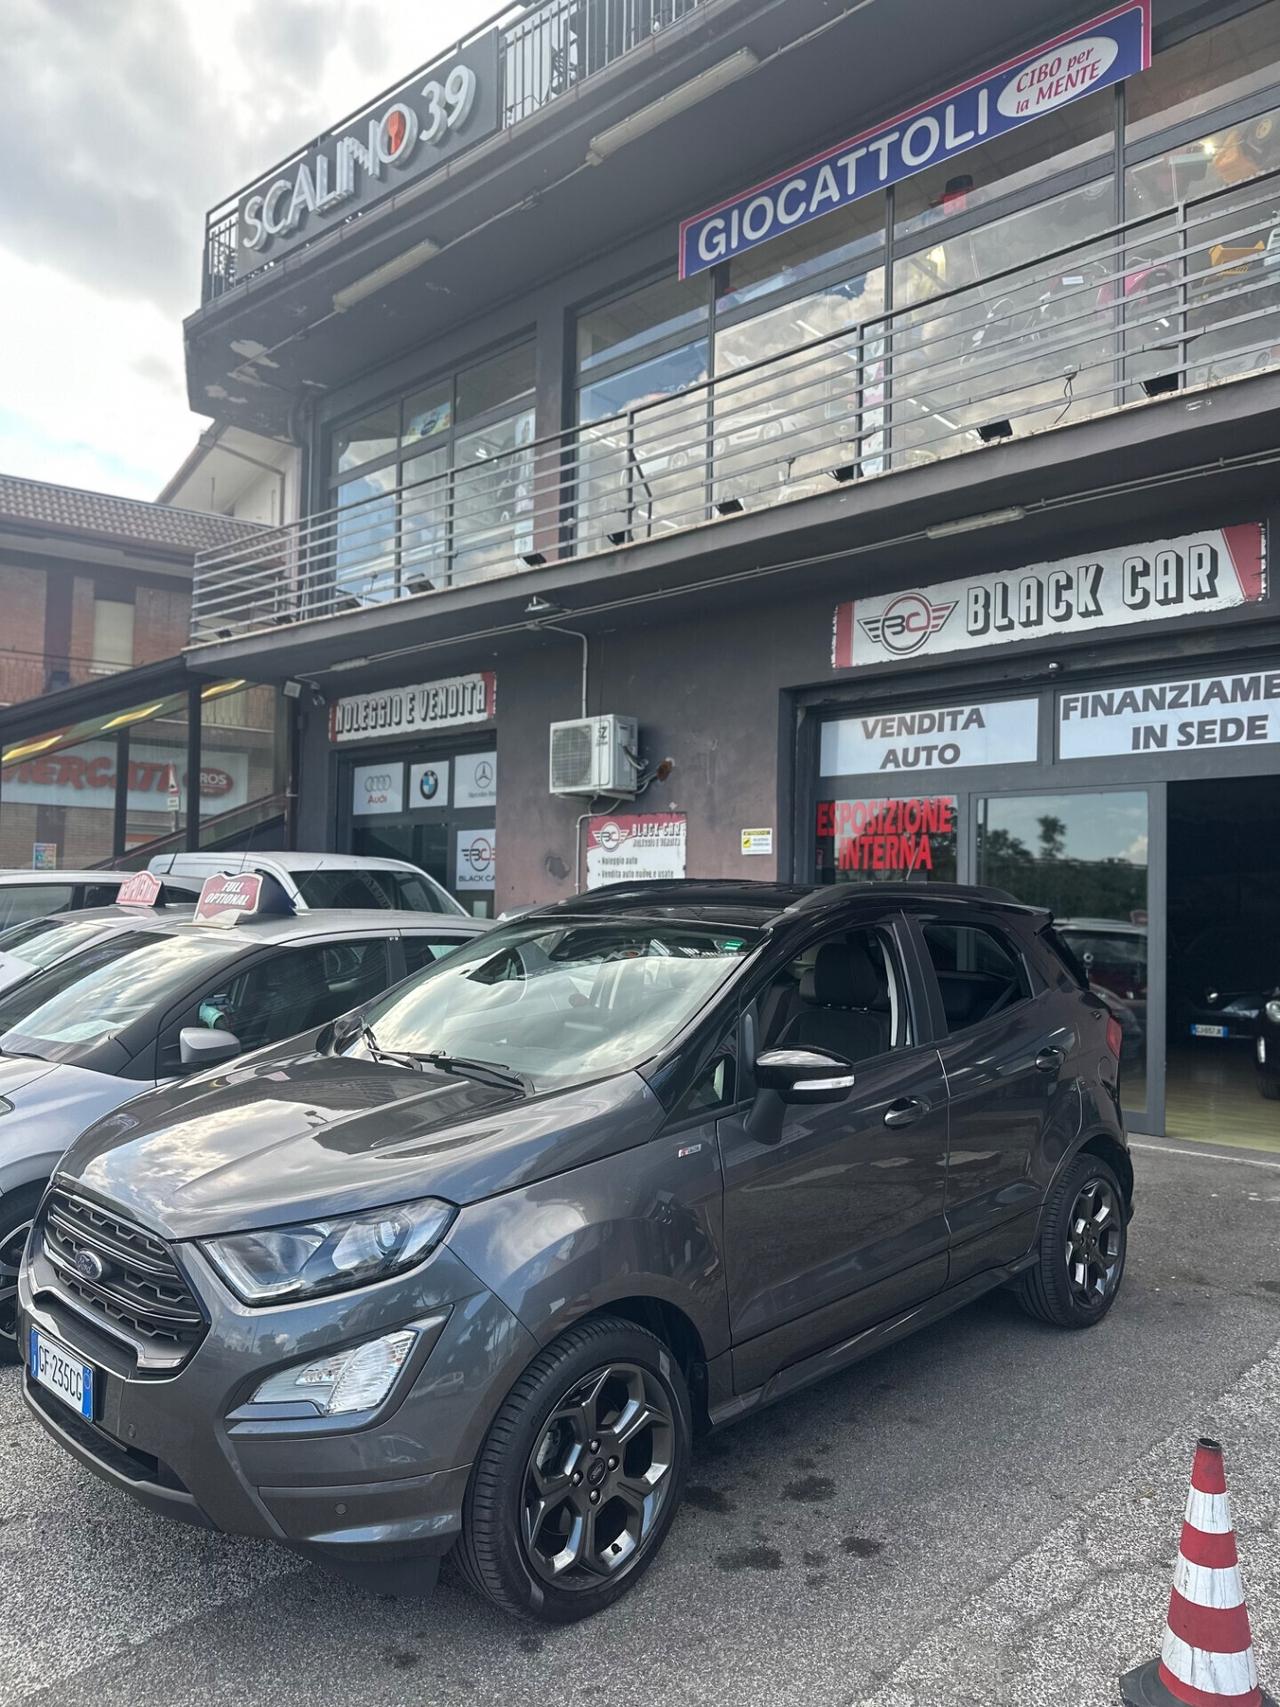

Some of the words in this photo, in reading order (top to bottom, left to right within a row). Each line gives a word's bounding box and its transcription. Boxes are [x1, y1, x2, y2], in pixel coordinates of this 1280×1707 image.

[1016, 57, 1062, 93] CIBO
[1066, 47, 1094, 72] per
[1016, 98, 1030, 114] la
[1036, 58, 1102, 105] MENTE
[243, 103, 418, 250] SCALINO
[419, 64, 477, 145] 39
[698, 88, 989, 262] GIOCATTOLI
[966, 563, 1104, 637] BLACK
[1121, 543, 1219, 610] CAR
[335, 694, 403, 734] NOLEGGIO
[406, 691, 415, 724] E
[419, 680, 486, 722] VENDITA
[1061, 672, 1280, 721] FINANZIAME
[861, 707, 986, 740] VENDITA
[1131, 724, 1168, 751] IN
[1177, 715, 1269, 748] SEDE
[880, 743, 961, 770] AUTO
[816, 797, 953, 837] ESPOSIZIONE
[838, 834, 933, 870] INTERNA
[204, 894, 250, 906] OPTIONAL
[222, 880, 244, 892] FULL
